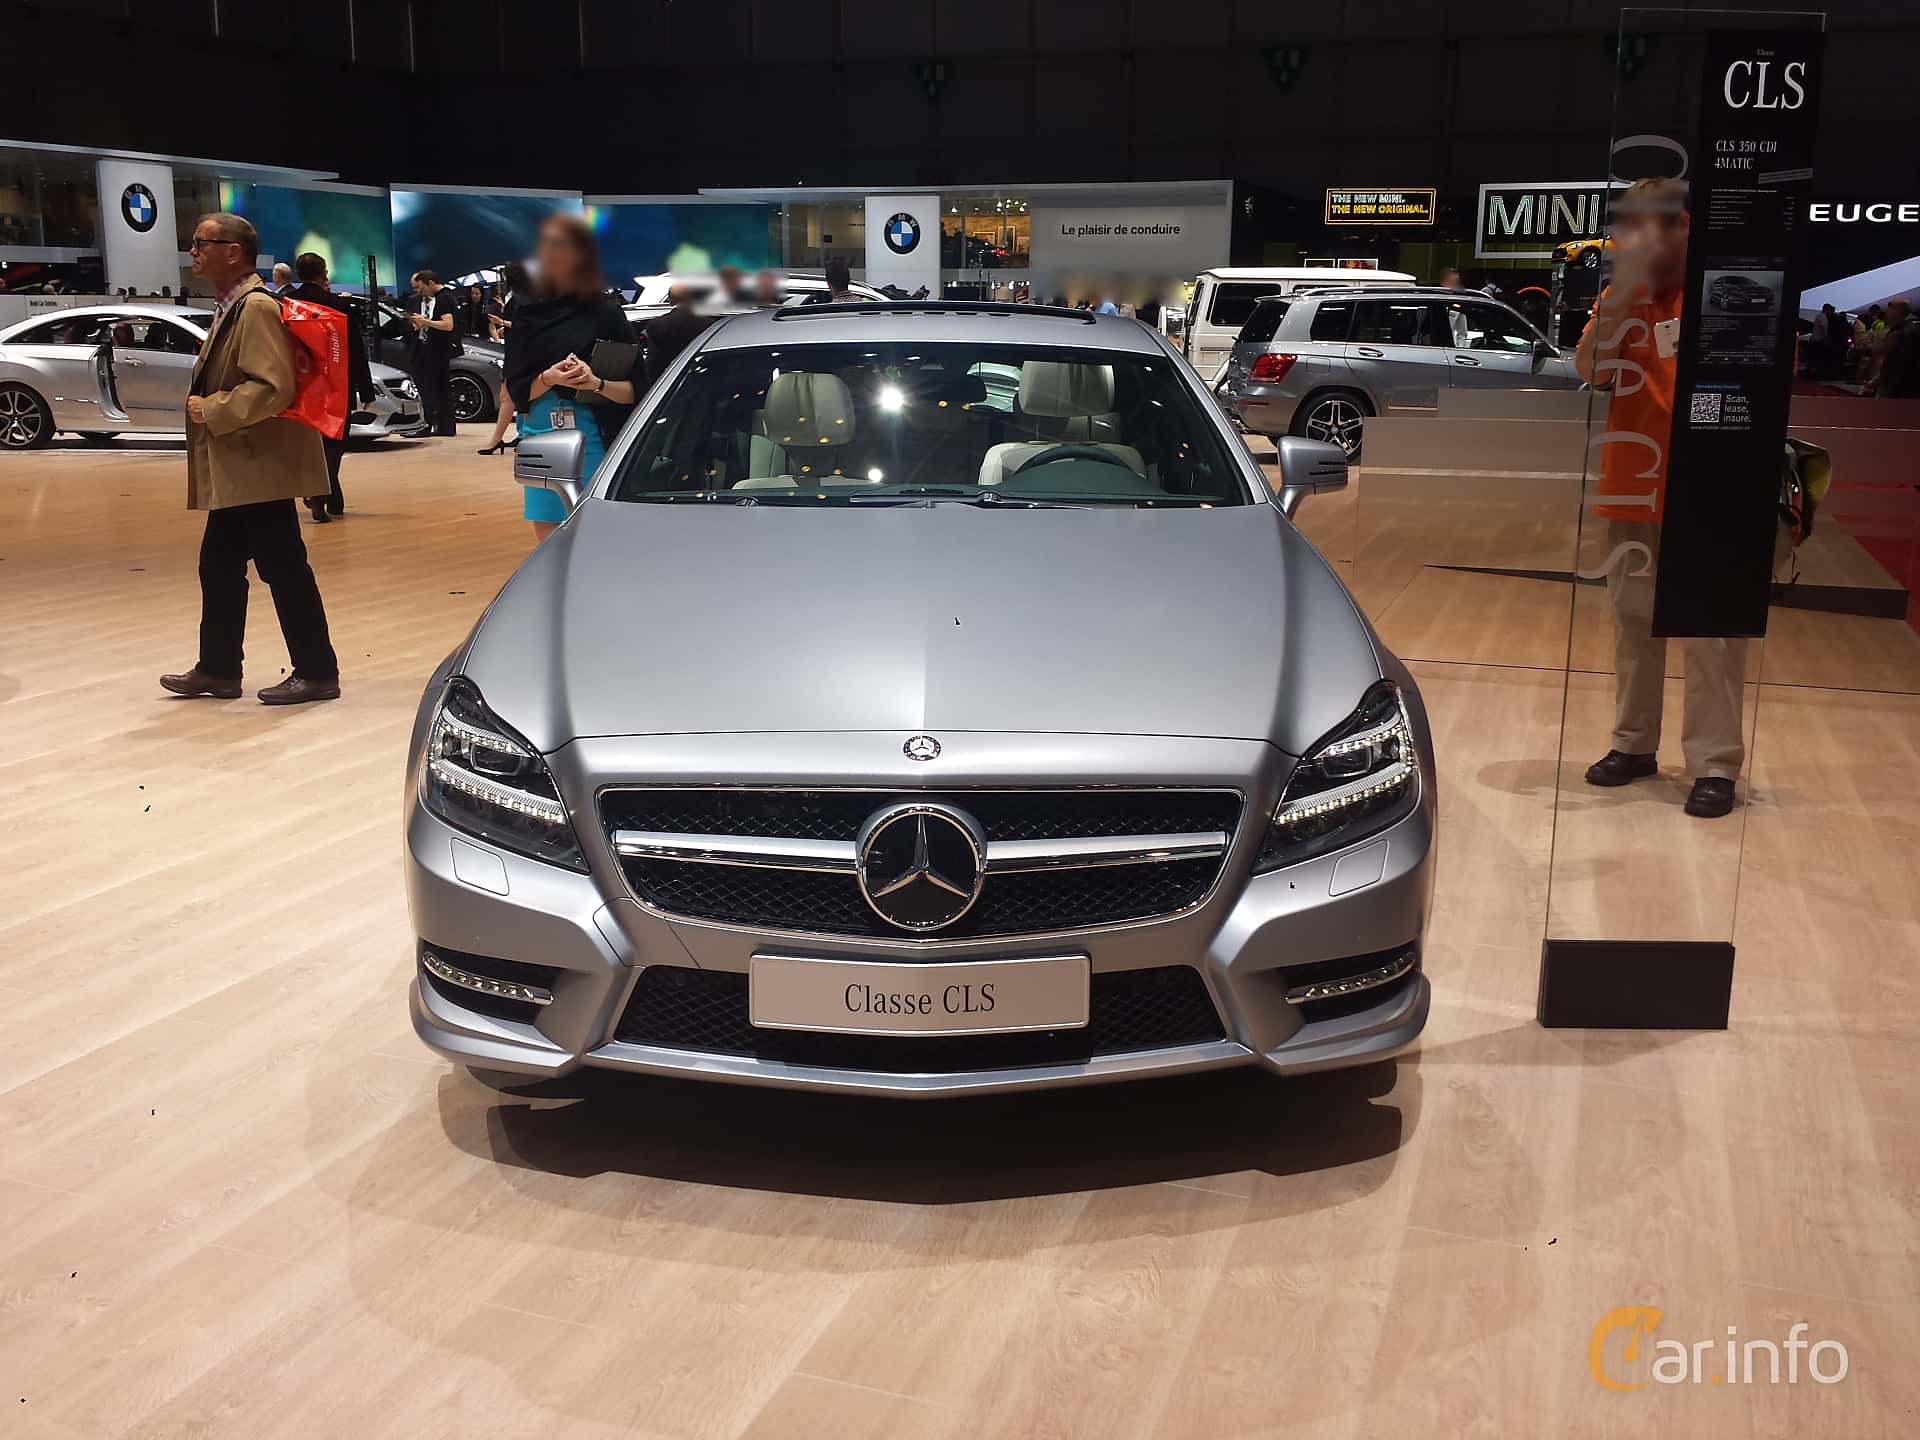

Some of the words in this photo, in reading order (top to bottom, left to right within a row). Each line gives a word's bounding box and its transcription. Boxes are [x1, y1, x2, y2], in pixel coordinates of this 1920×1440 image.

[1724, 60, 1806, 110] CLS
[1715, 140, 1735, 152] CLS
[1738, 140, 1757, 152] 350
[1759, 141, 1777, 153] CDI
[1714, 157, 1754, 170] 4MATIC
[1332, 194, 1352, 203] THE
[1353, 194, 1377, 203] NEW
[1331, 204, 1351, 214] THE
[1353, 204, 1377, 214] NEW
[1378, 204, 1429, 214] ORIGINAL.
[1488, 194, 1600, 235] MINI
[1809, 203, 1920, 222] EUGE
[1062, 224, 1075, 235] Le
[1078, 224, 1111, 238] plaisir
[1114, 224, 1128, 235] de
[1131, 223, 1181, 235] conduire
[1726, 394, 1749, 404] Scan,
[845, 984, 932, 1015] Classe
[943, 983, 995, 1014] CLS
